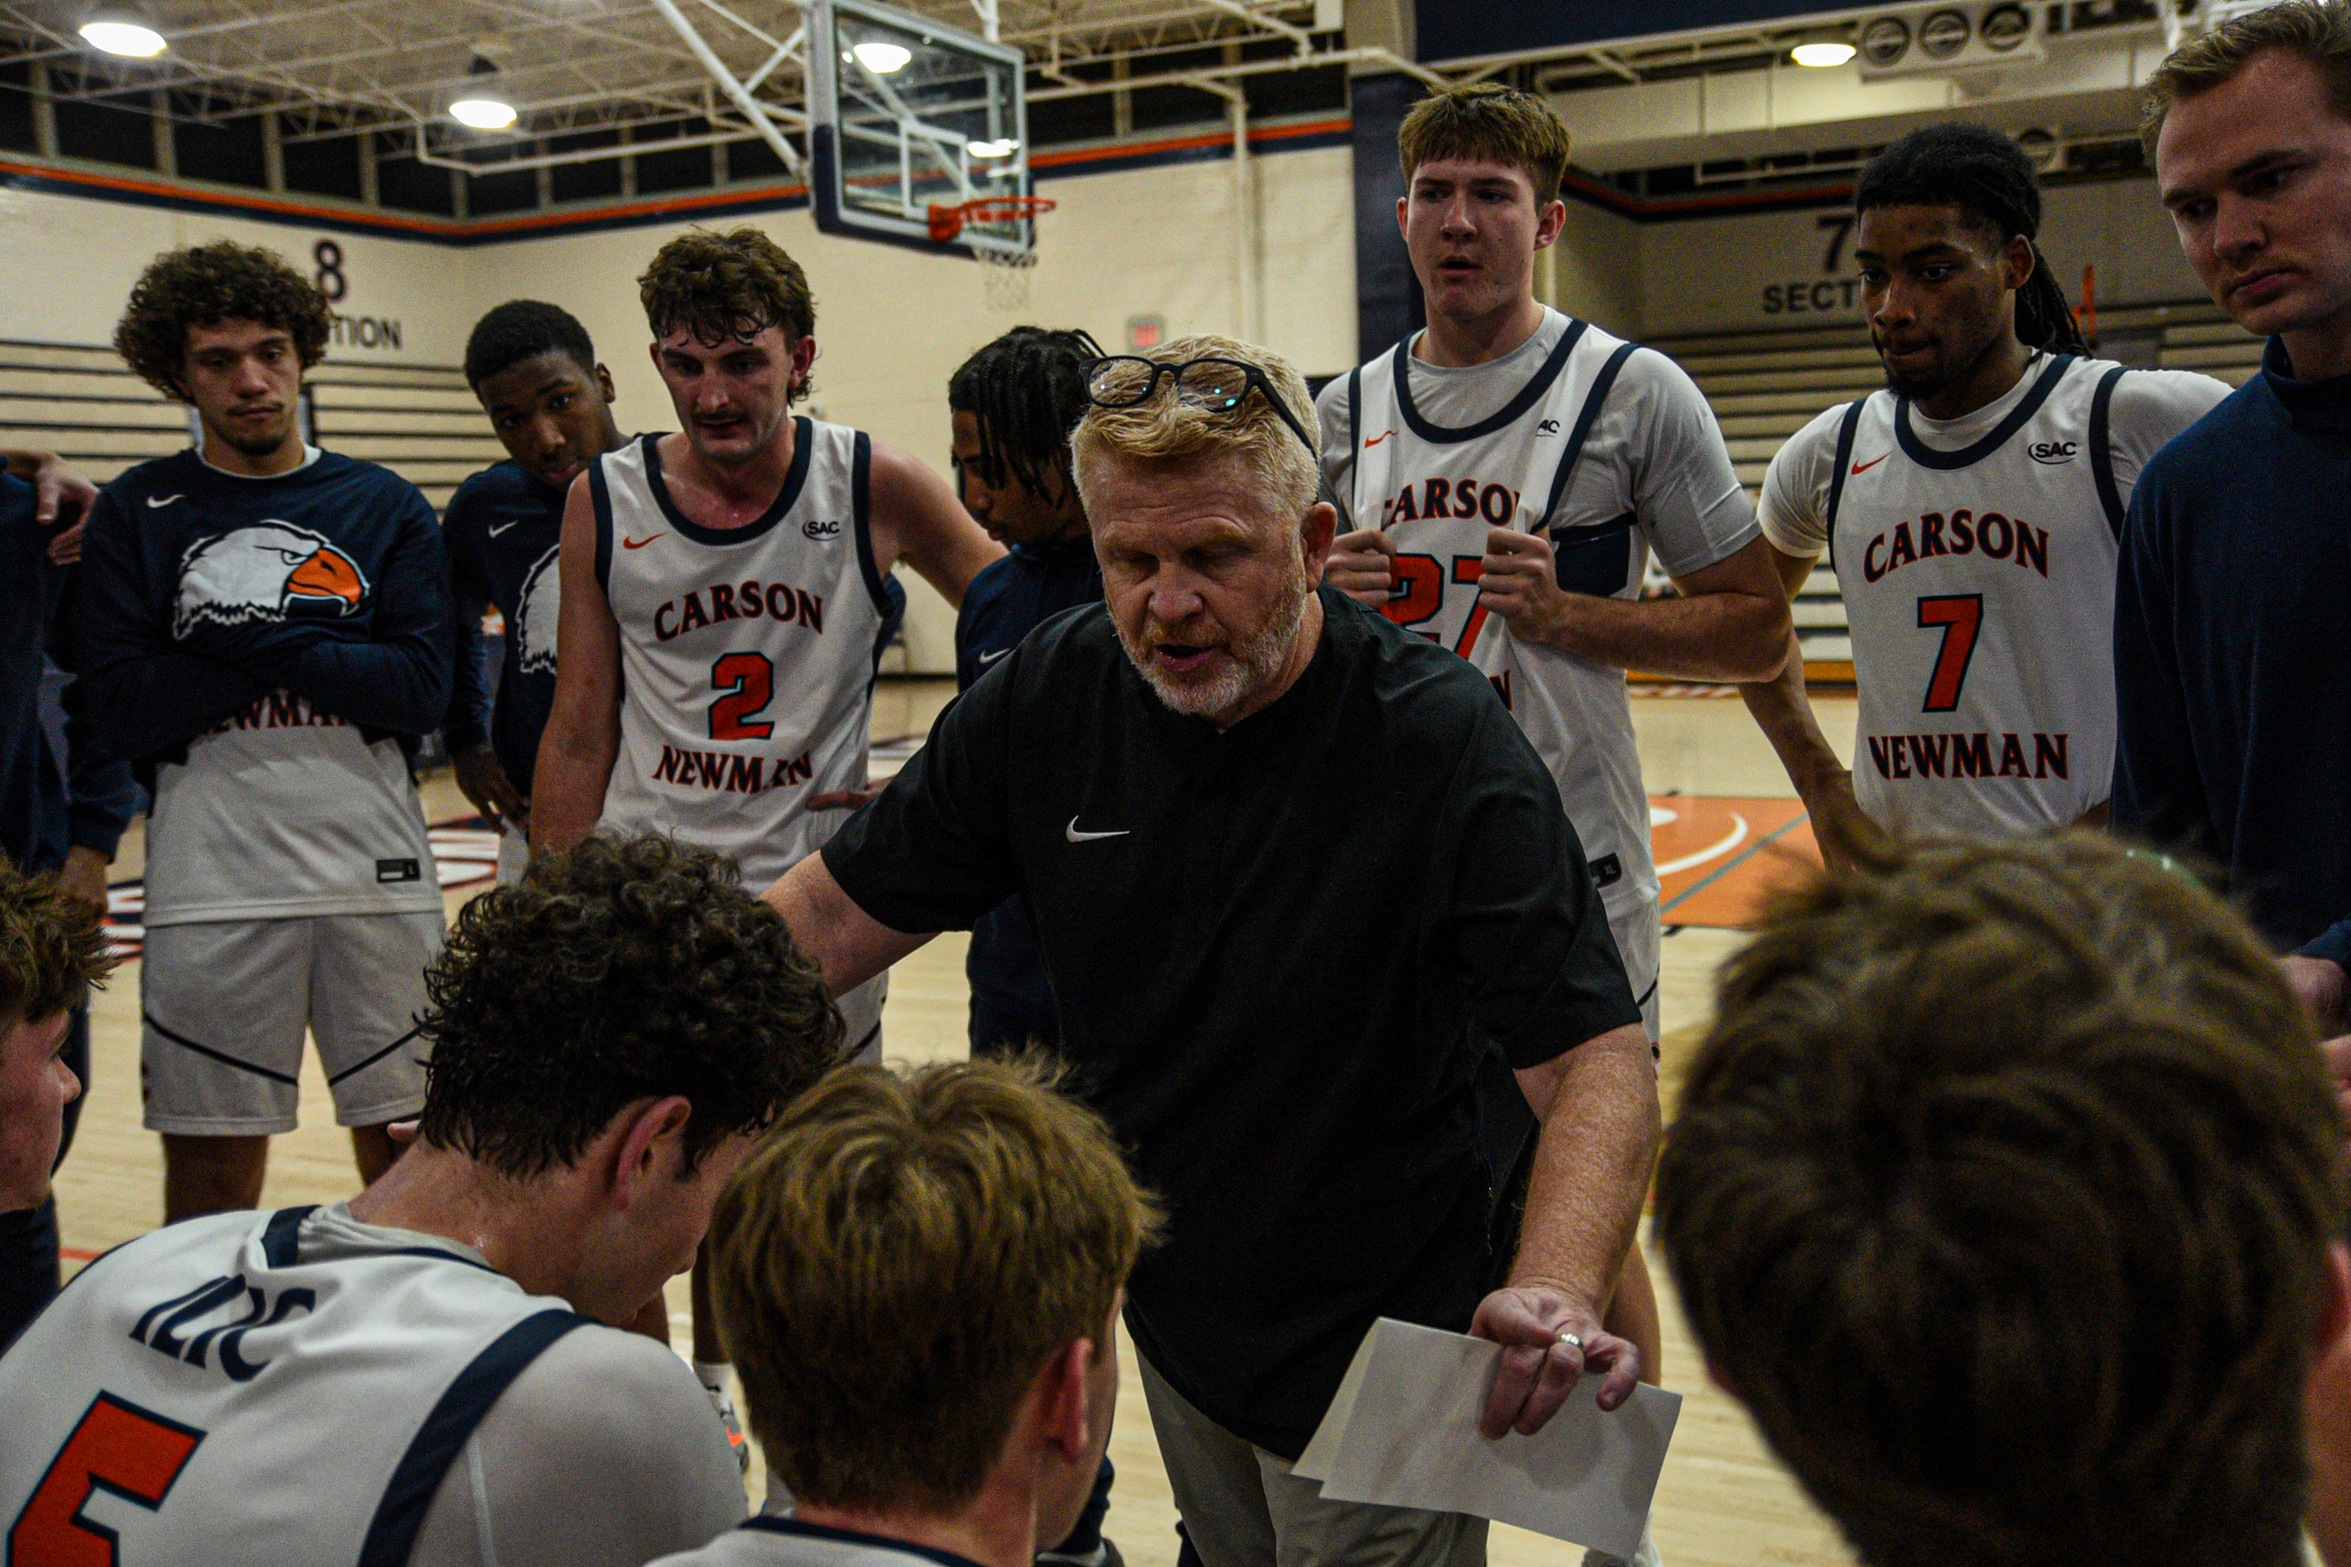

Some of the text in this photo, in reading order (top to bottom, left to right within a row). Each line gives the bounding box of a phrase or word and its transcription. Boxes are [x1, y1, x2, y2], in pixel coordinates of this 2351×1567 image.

[1817, 214, 1856, 272] 7
[315, 240, 347, 303] 8
[1763, 280, 1862, 313] SECT
[334, 315, 402, 350] TION
[1537, 419, 1561, 435] AC
[2033, 441, 2078, 459] SAC
[806, 520, 841, 537] SAC
[1382, 477, 1521, 532] ARSO
[1863, 508, 2050, 584] CARSON
[653, 579, 823, 643] CARSON
[1380, 553, 1490, 661] 27
[1916, 593, 1985, 713] 7
[707, 650, 775, 741] 2
[651, 744, 813, 795] NEWMAN
[1867, 731, 2069, 782] NEWMAN
